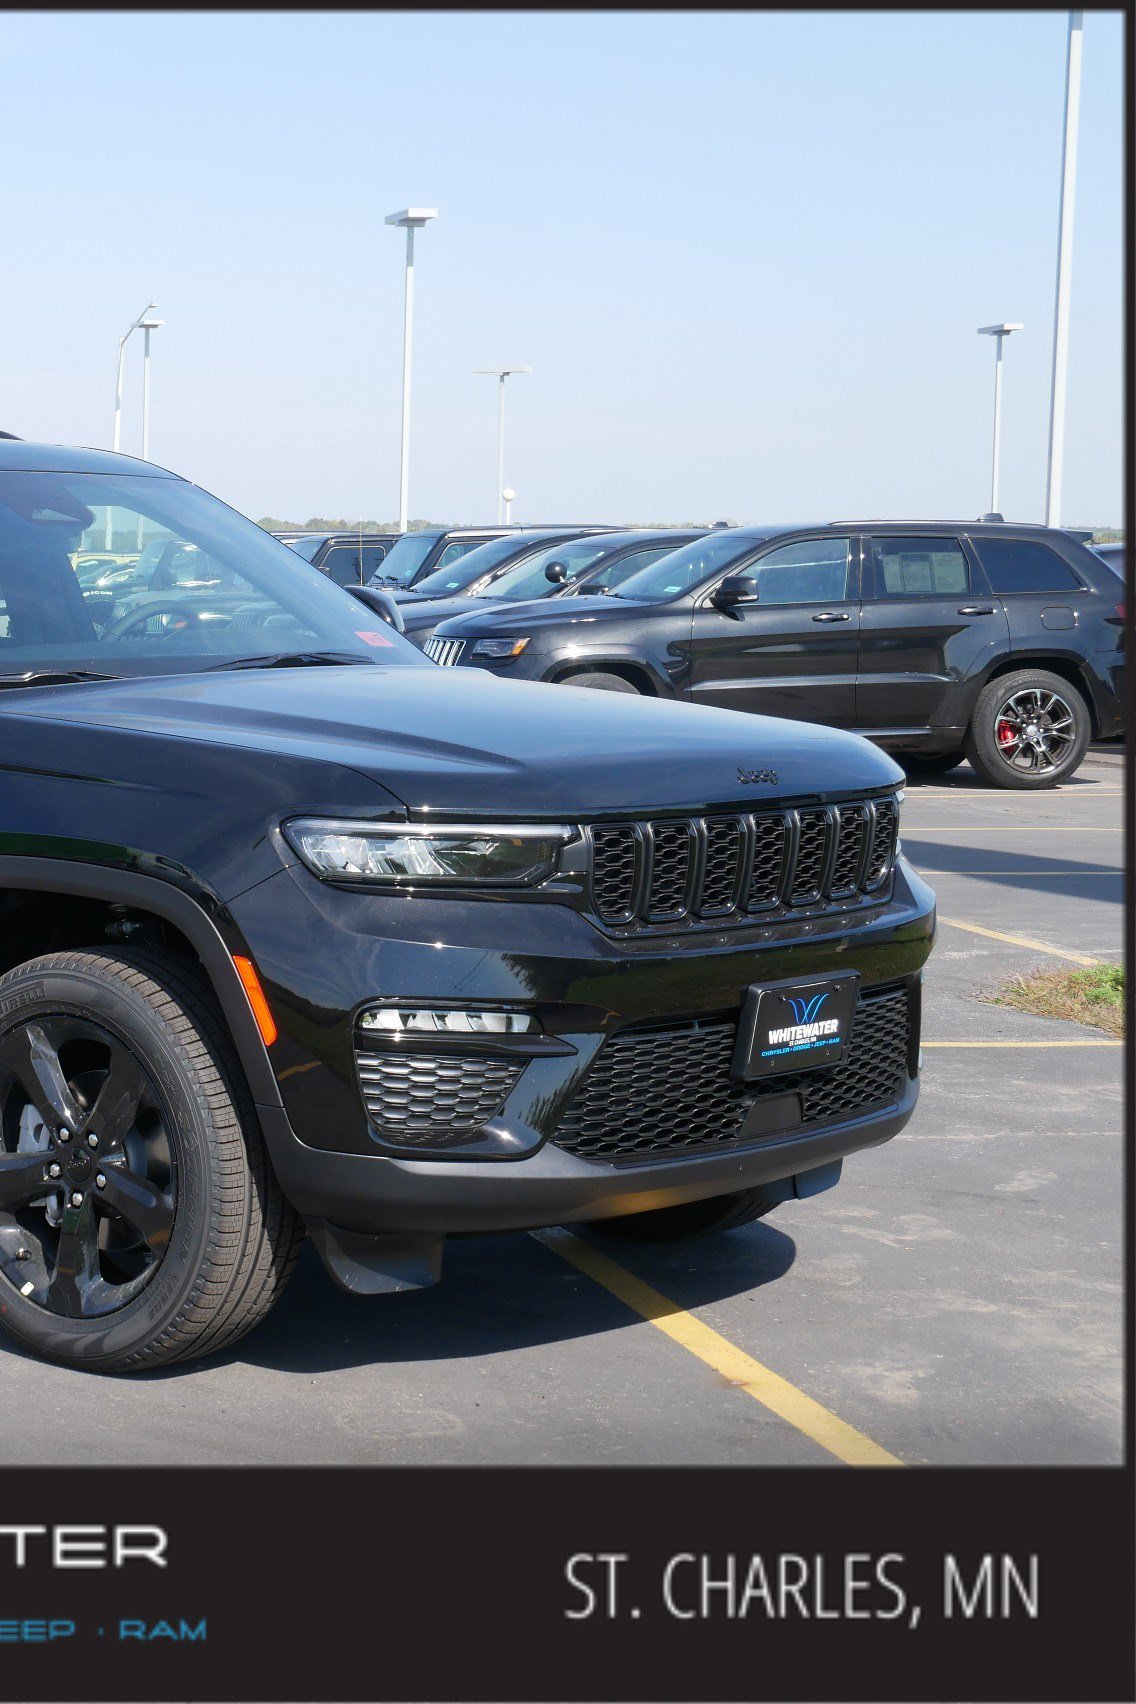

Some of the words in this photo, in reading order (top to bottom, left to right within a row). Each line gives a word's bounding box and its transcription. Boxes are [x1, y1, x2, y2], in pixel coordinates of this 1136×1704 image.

[736, 766, 779, 786] Jeep
[768, 1019, 838, 1045] WHITEWATER
[761, 1048, 790, 1057] CHRYSLER
